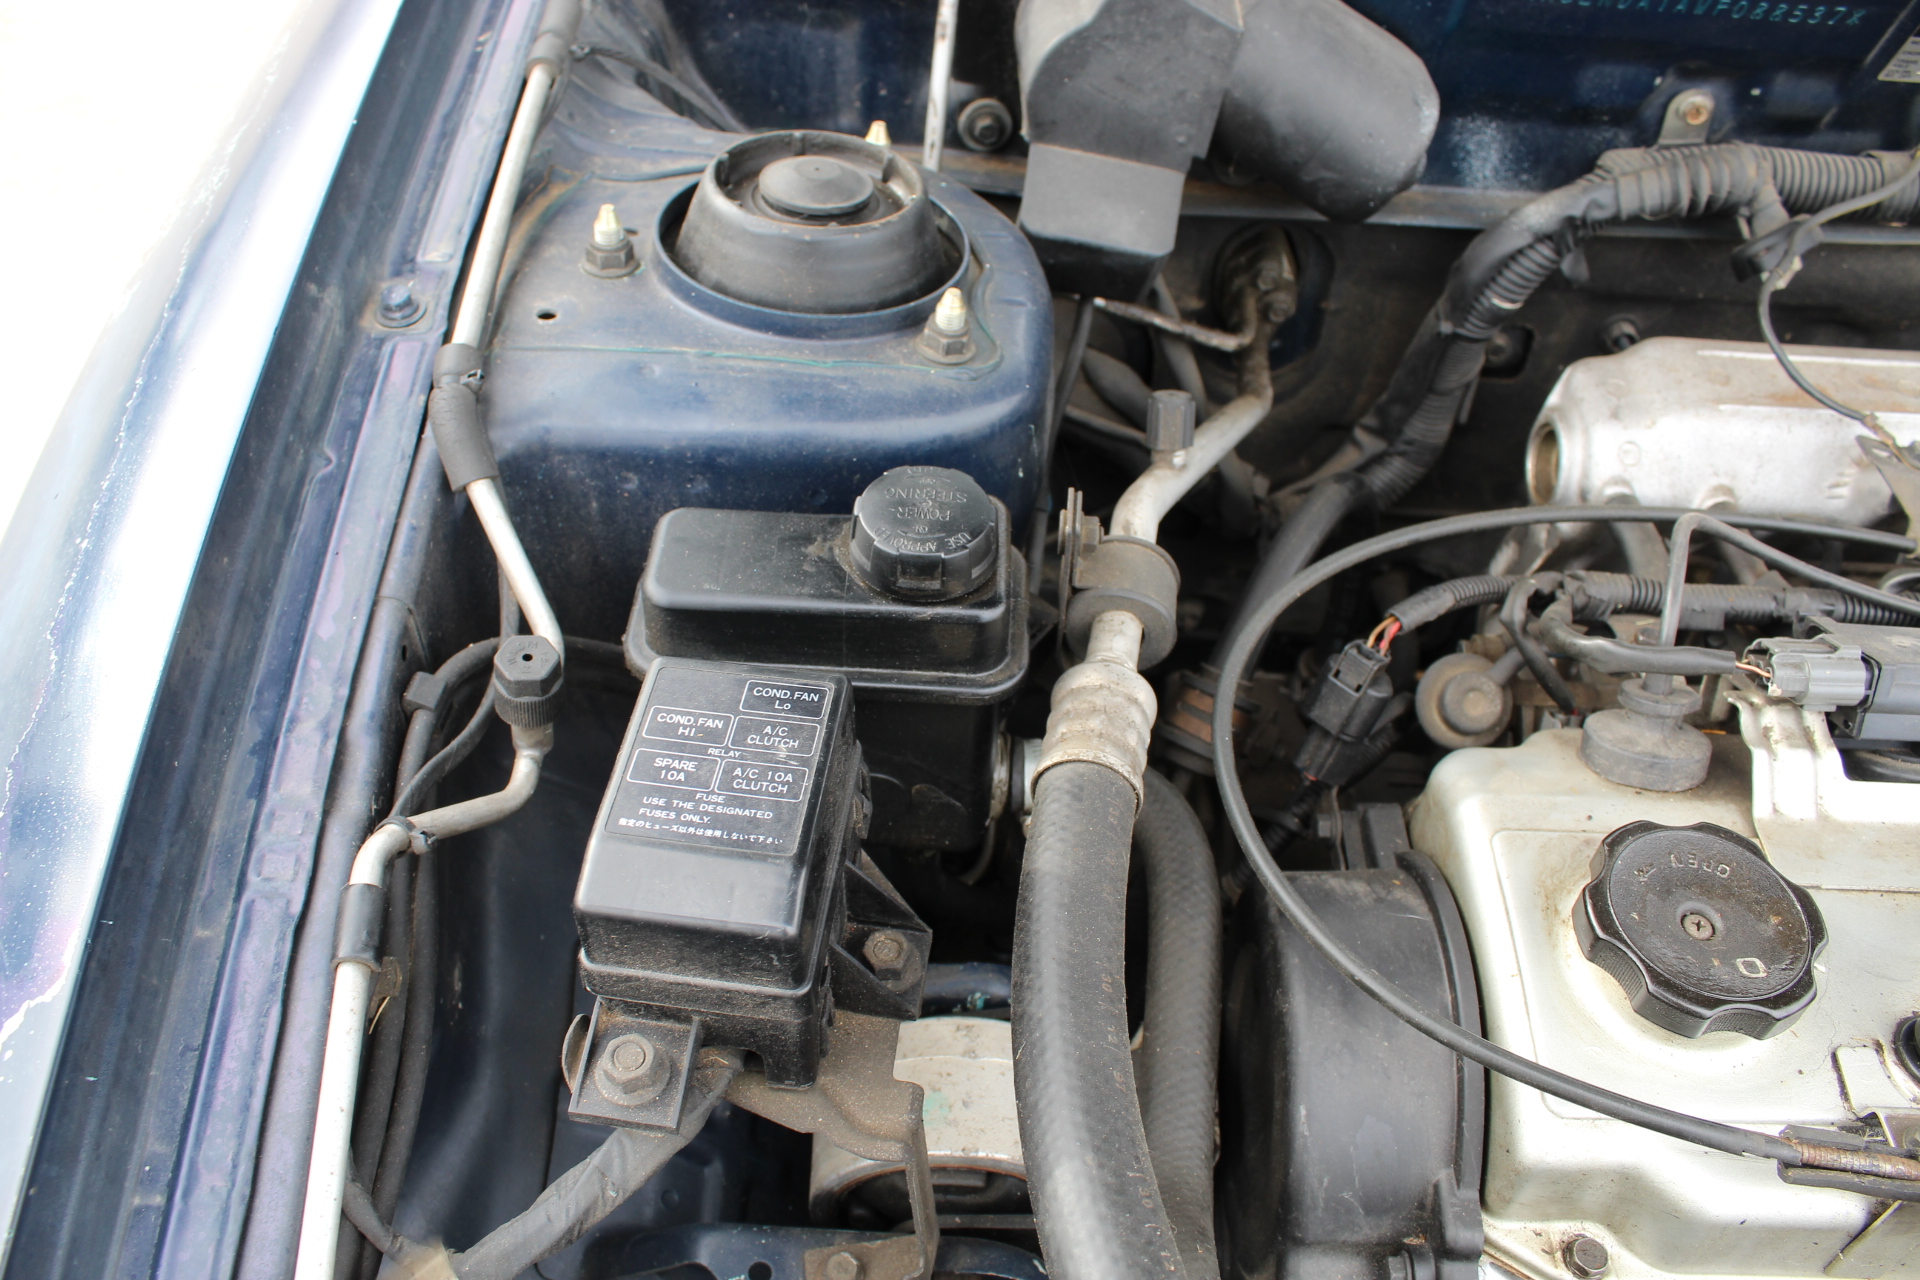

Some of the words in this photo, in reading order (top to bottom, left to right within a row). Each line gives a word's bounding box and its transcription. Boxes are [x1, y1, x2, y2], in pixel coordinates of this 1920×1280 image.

[884, 487, 968, 503] STEERING
[896, 506, 950, 521] POWER
[874, 527, 938, 552] APPROVED
[944, 531, 972, 550] USE
[753, 686, 819, 702] COND.FAN
[774, 700, 791, 710] Lo
[656, 712, 723, 729] COND.FAN
[762, 725, 788, 736] A/C
[747, 735, 799, 749] CLUTCH
[707, 748, 741, 758] RELAY
[653, 757, 698, 772] SPARE
[660, 770, 685, 782] 10A
[732, 768, 758, 779] A/C
[767, 770, 793, 783] 10A
[732, 779, 788, 794] CLUTCH
[695, 793, 726, 803] FUSE
[643, 796, 667, 806] USE
[672, 800, 696, 809] THE
[699, 803, 774, 819] DESIGNATED
[638, 807, 677, 820] FUSES
[680, 813, 711, 824] ONLY.
[1670, 852, 1731, 879] OPEN
